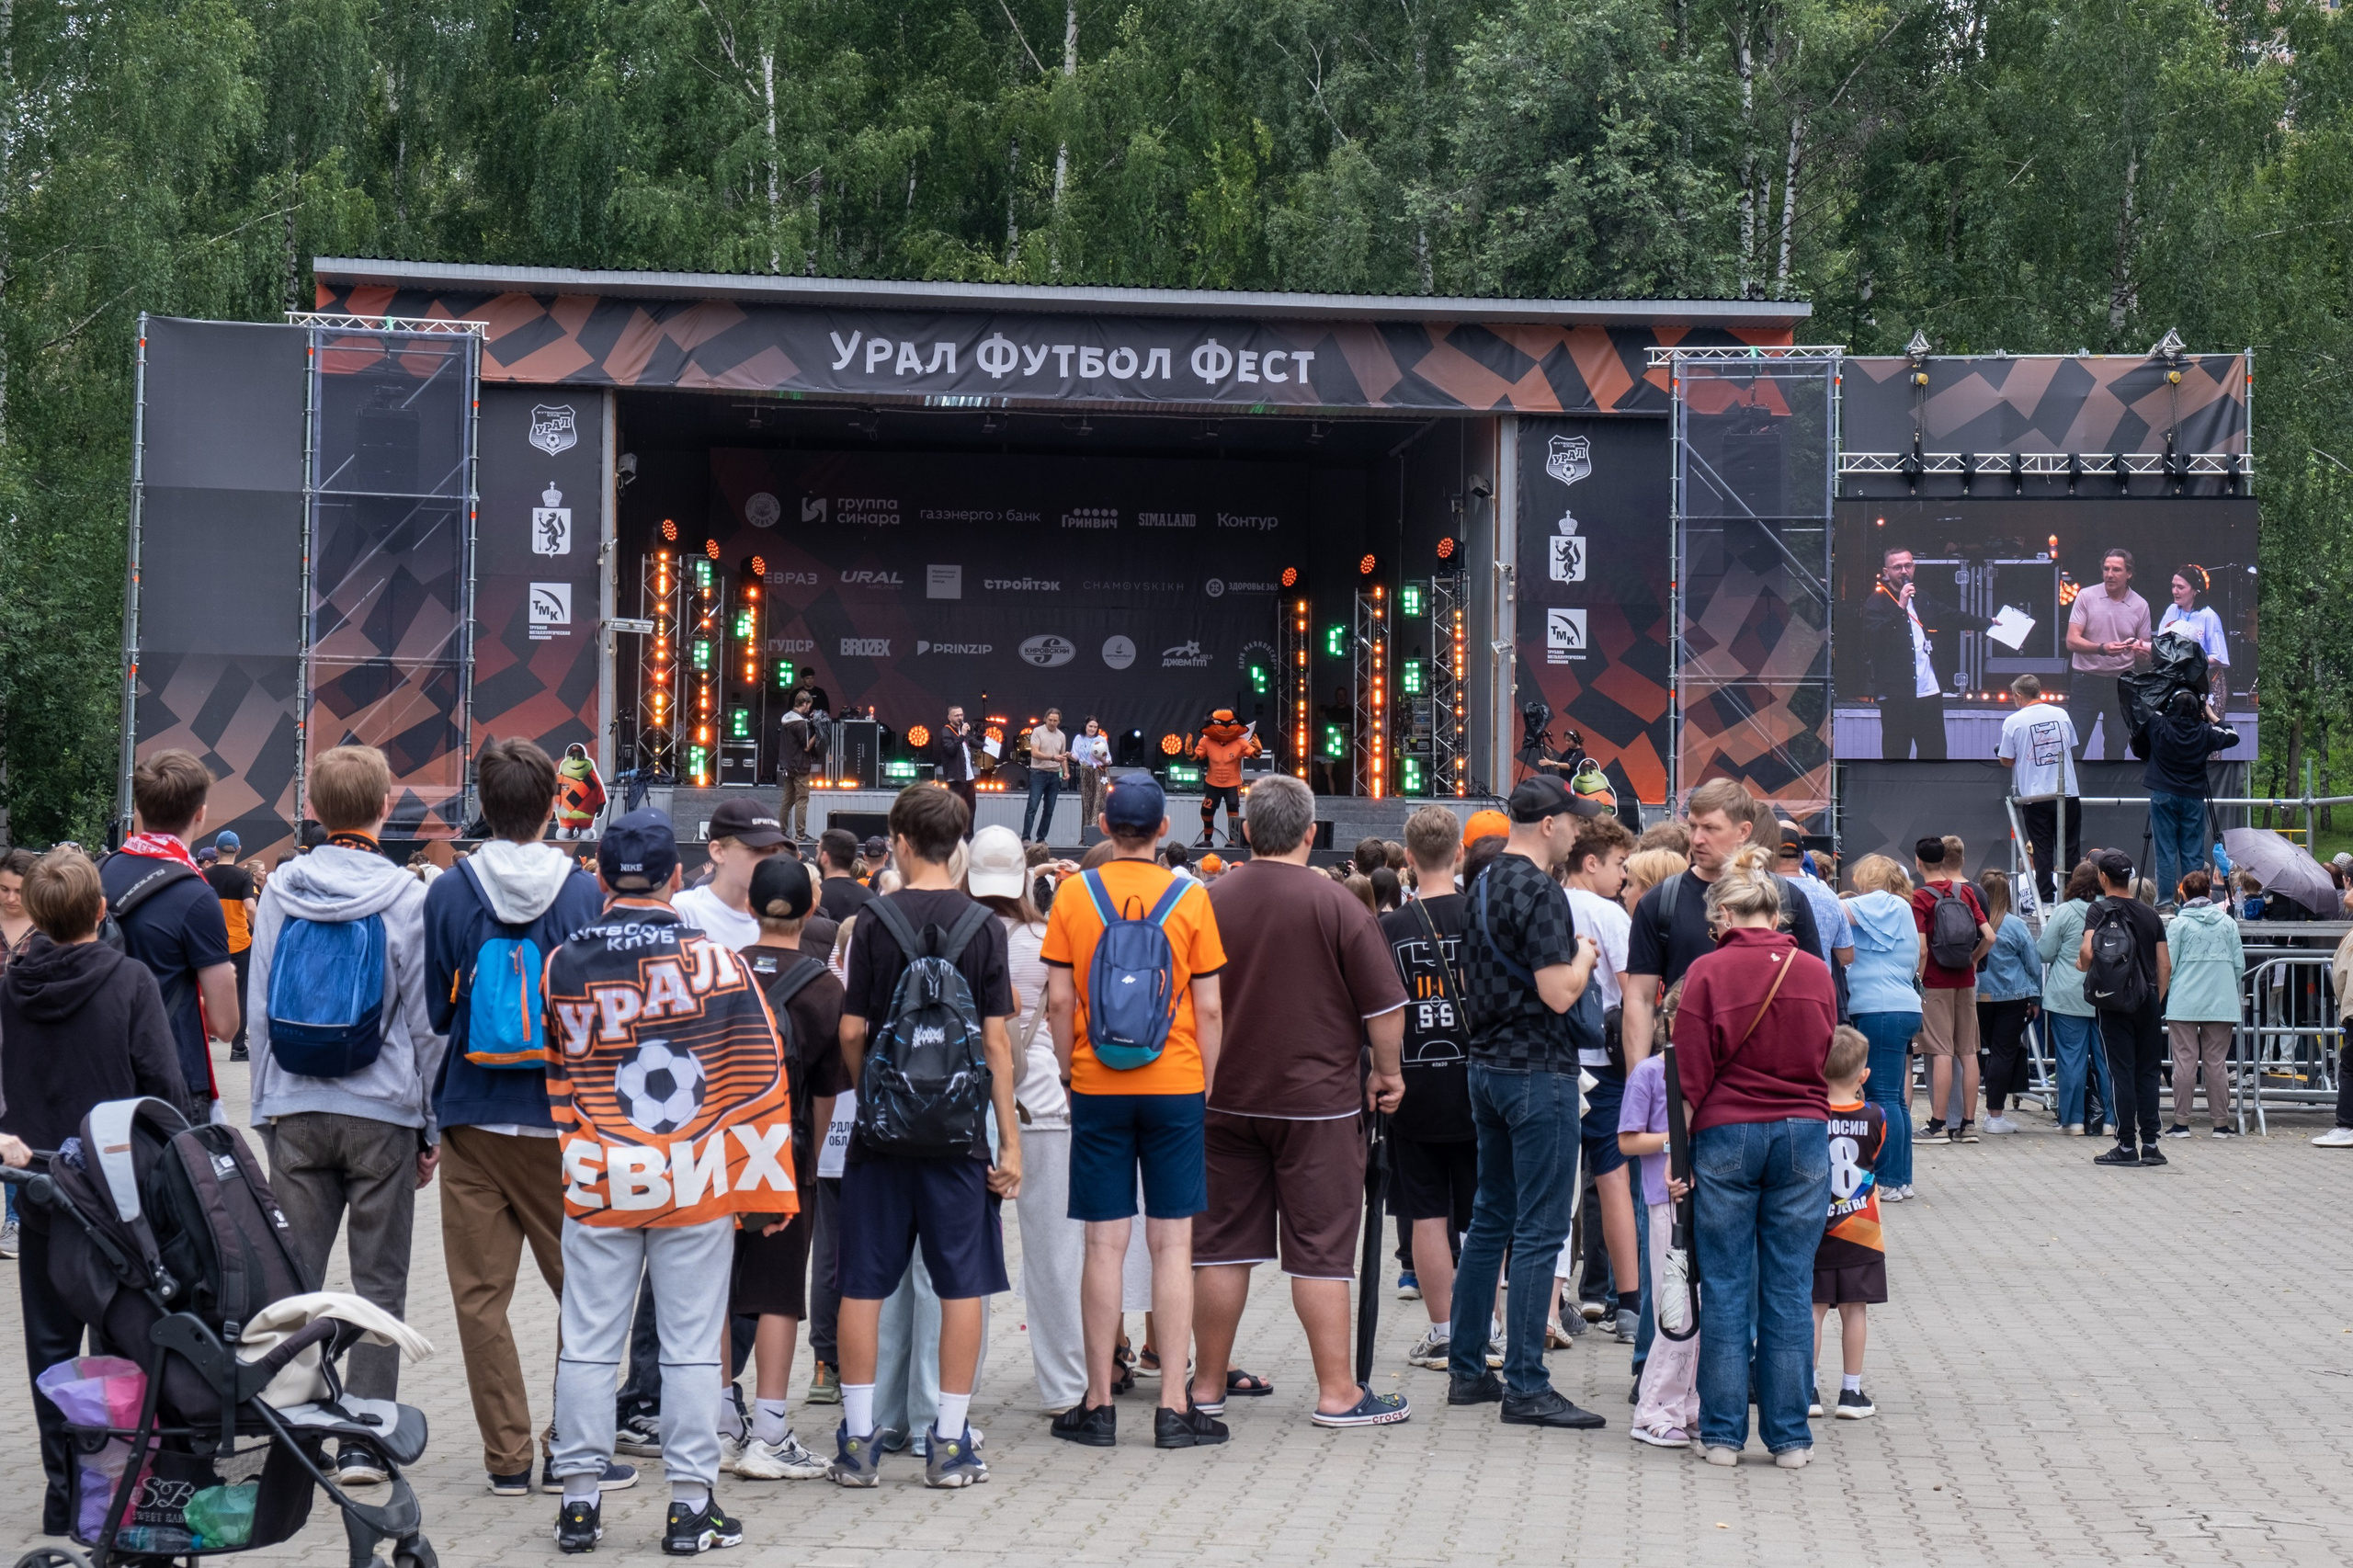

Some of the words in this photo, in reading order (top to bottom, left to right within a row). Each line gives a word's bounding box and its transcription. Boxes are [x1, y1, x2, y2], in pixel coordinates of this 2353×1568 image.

[830, 330, 957, 377] УРАЛ
[976, 332, 1172, 380] ФУТБОЛ
[1191, 338, 1314, 384] ФЕСТ
[535, 417, 571, 436] УРАЛ
[1552, 448, 1586, 465] УРАЛ
[837, 498, 898, 511] группа
[836, 512, 900, 527] синара
[920, 509, 994, 523] газэнерго
[1006, 509, 1041, 522] банк
[1138, 513, 1197, 527] SIMALAND
[1217, 512, 1279, 530] Контур
[763, 572, 818, 585] ЕВРАЗ
[840, 571, 904, 584] URAL
[983, 577, 1061, 591] СТРОЙТЭК
[1228, 582, 1265, 592] ЗДОРОВЬЕ
[1266, 583, 1279, 591] 365
[532, 600, 559, 621] ТМК
[1551, 625, 1575, 645] ТМК
[933, 643, 993, 654] PRINZIP
[620, 863, 643, 872] NIKE
[607, 929, 676, 952] КЛУБ
[553, 939, 744, 1056] УРАЛ
[829, 1135, 847, 1146] ОБЛ
[1829, 1137, 1862, 1199] 8
[1372, 1411, 1404, 1424] crocs
